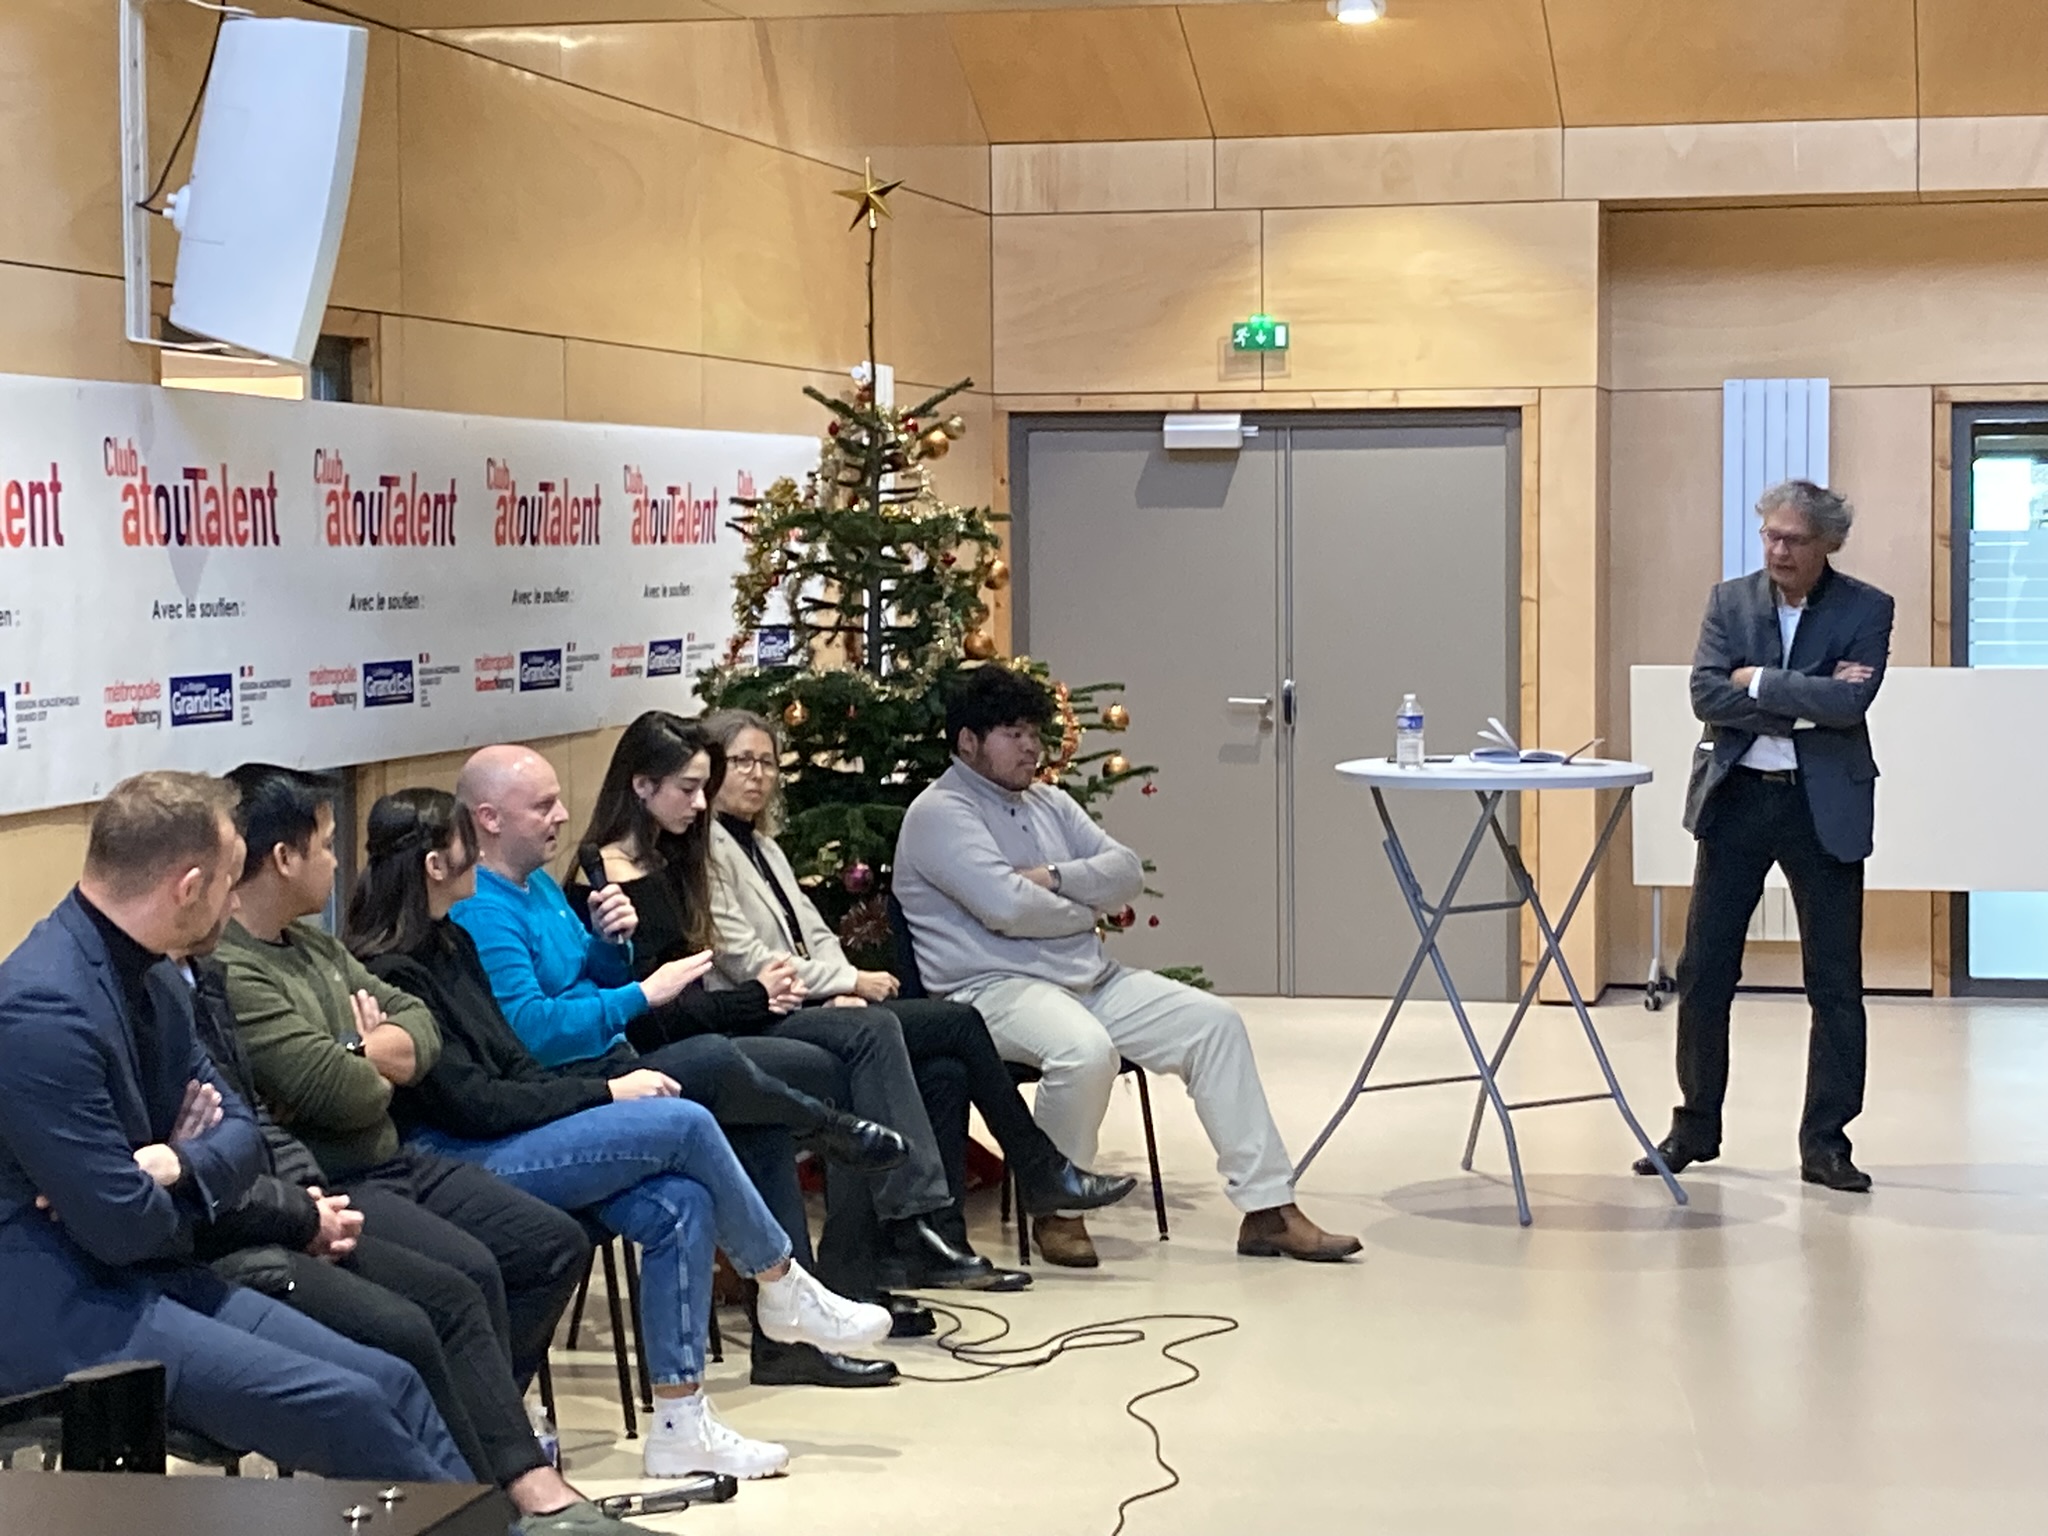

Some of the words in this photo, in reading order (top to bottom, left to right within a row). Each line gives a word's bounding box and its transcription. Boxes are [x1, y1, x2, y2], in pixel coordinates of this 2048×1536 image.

[104, 436, 138, 477] Club
[314, 448, 343, 484] Club
[0, 462, 64, 548] ent
[121, 463, 281, 547] atouTalent
[325, 471, 457, 547] atouTalent
[494, 477, 602, 547] atouTalent
[631, 482, 718, 545] atouTalent
[152, 600, 182, 619] Avec
[186, 598, 196, 619] le
[200, 597, 239, 618] soutien
[349, 593, 374, 611] Avec
[377, 591, 385, 611] le
